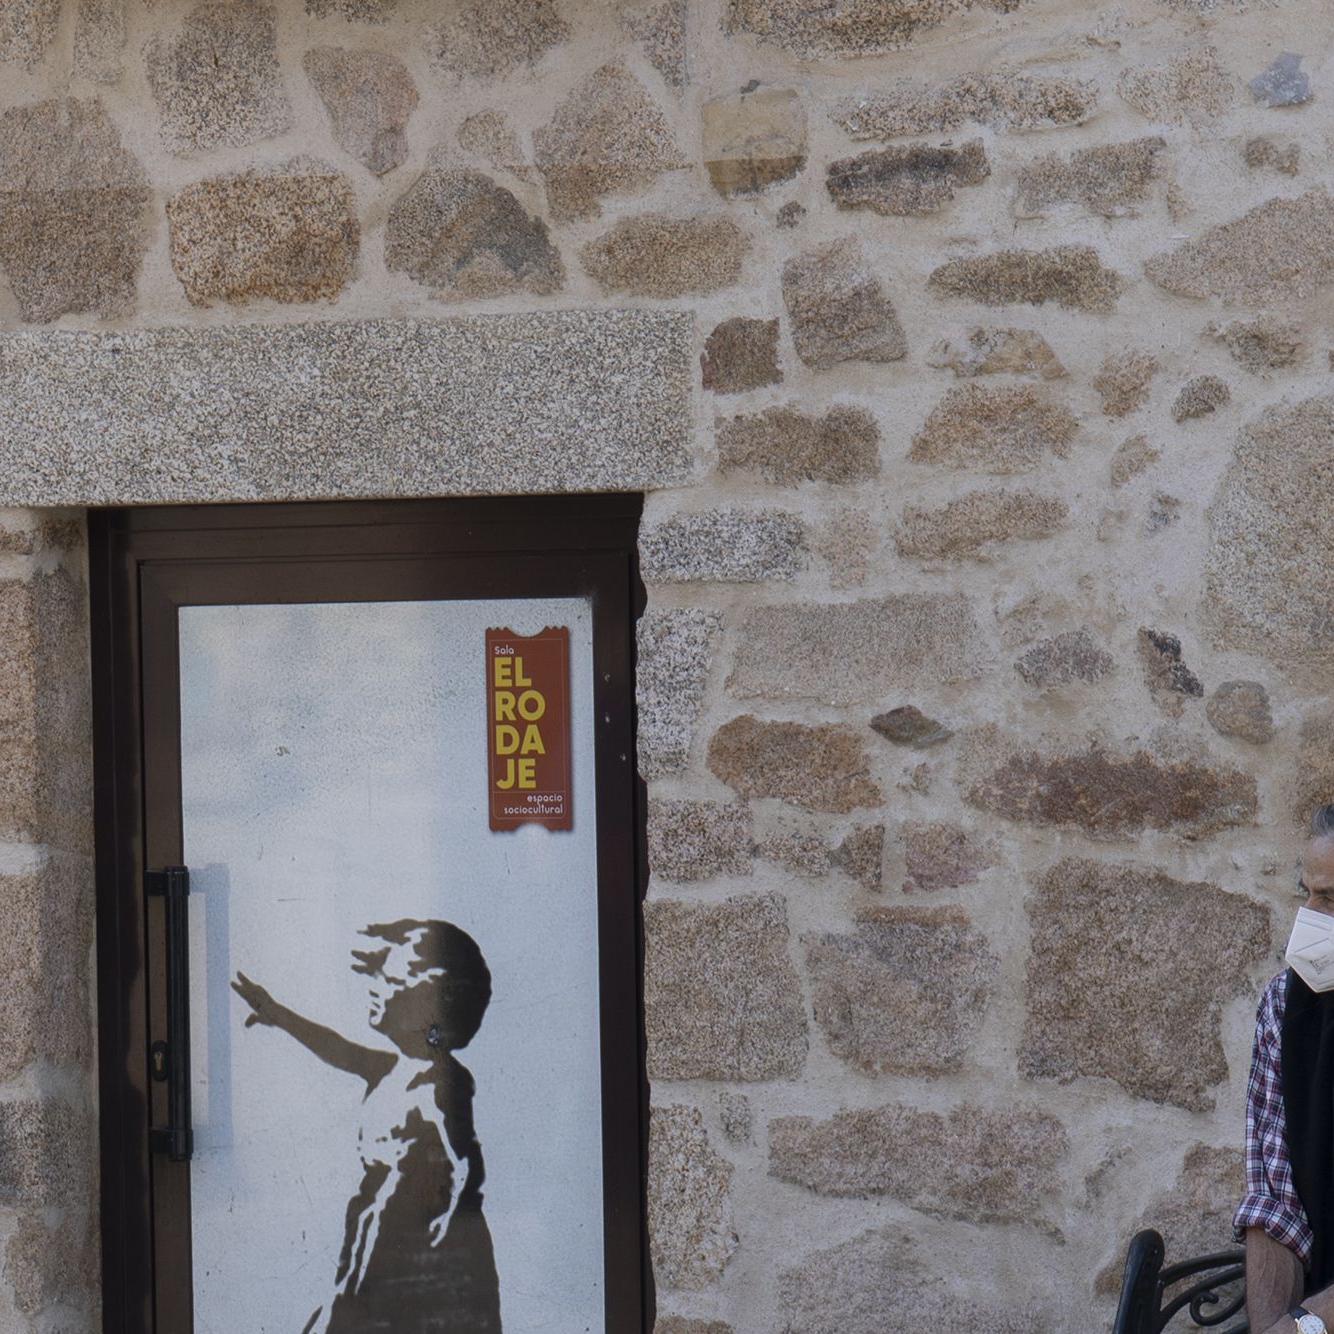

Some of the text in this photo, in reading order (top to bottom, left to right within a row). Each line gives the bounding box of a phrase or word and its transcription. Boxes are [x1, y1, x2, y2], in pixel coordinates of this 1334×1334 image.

[494, 643, 515, 655] Sala
[494, 656, 532, 687] EL
[495, 689, 546, 721] RO
[495, 724, 546, 755] DA
[496, 758, 537, 790] JE
[504, 804, 564, 815] sociocultural
[527, 794, 564, 804] espacio
